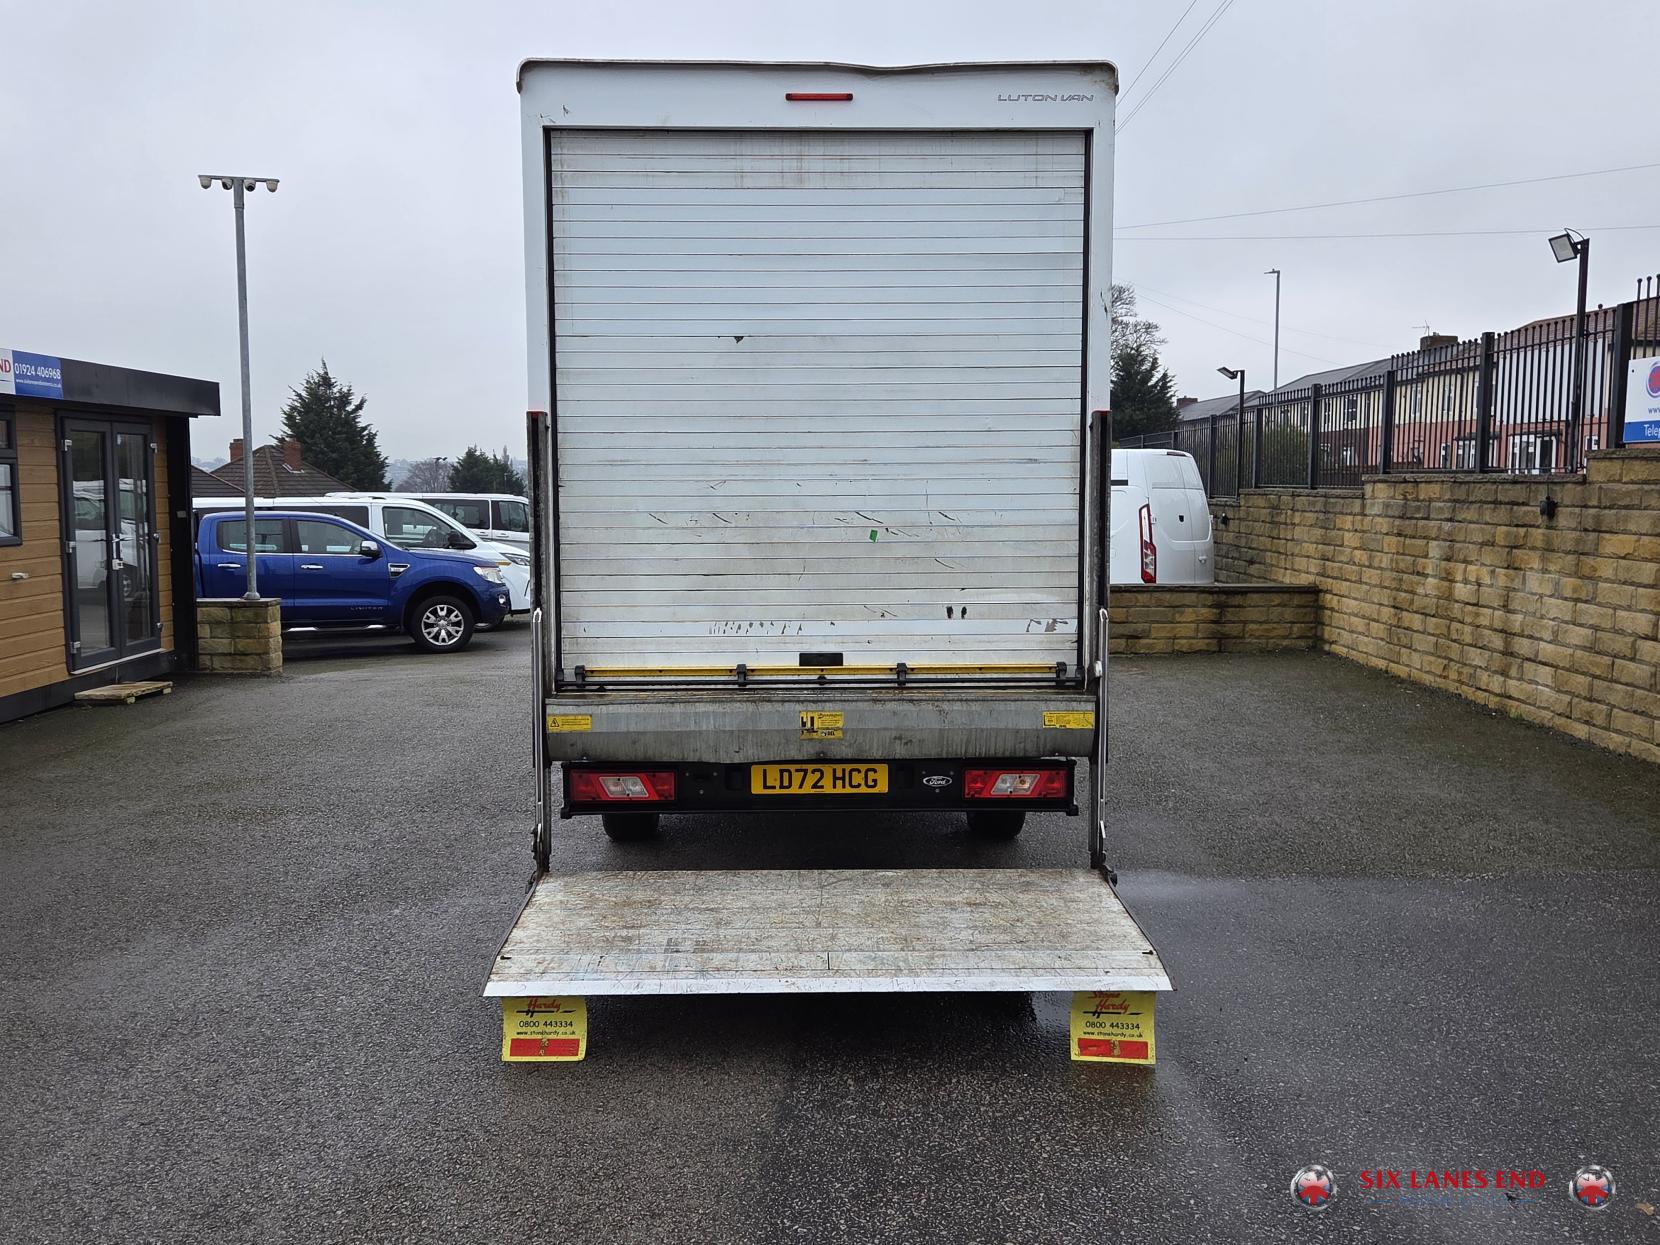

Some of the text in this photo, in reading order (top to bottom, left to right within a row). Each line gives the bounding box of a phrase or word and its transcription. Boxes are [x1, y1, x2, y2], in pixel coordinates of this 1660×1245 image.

[997, 94, 1094, 102] LUTON VAN
[14, 362, 61, 380] 01924 406968
[762, 768, 878, 790] LD72 HCG
[518, 1020, 573, 1028] 0800 443334
[1085, 1021, 1141, 1030] 0800 443334
